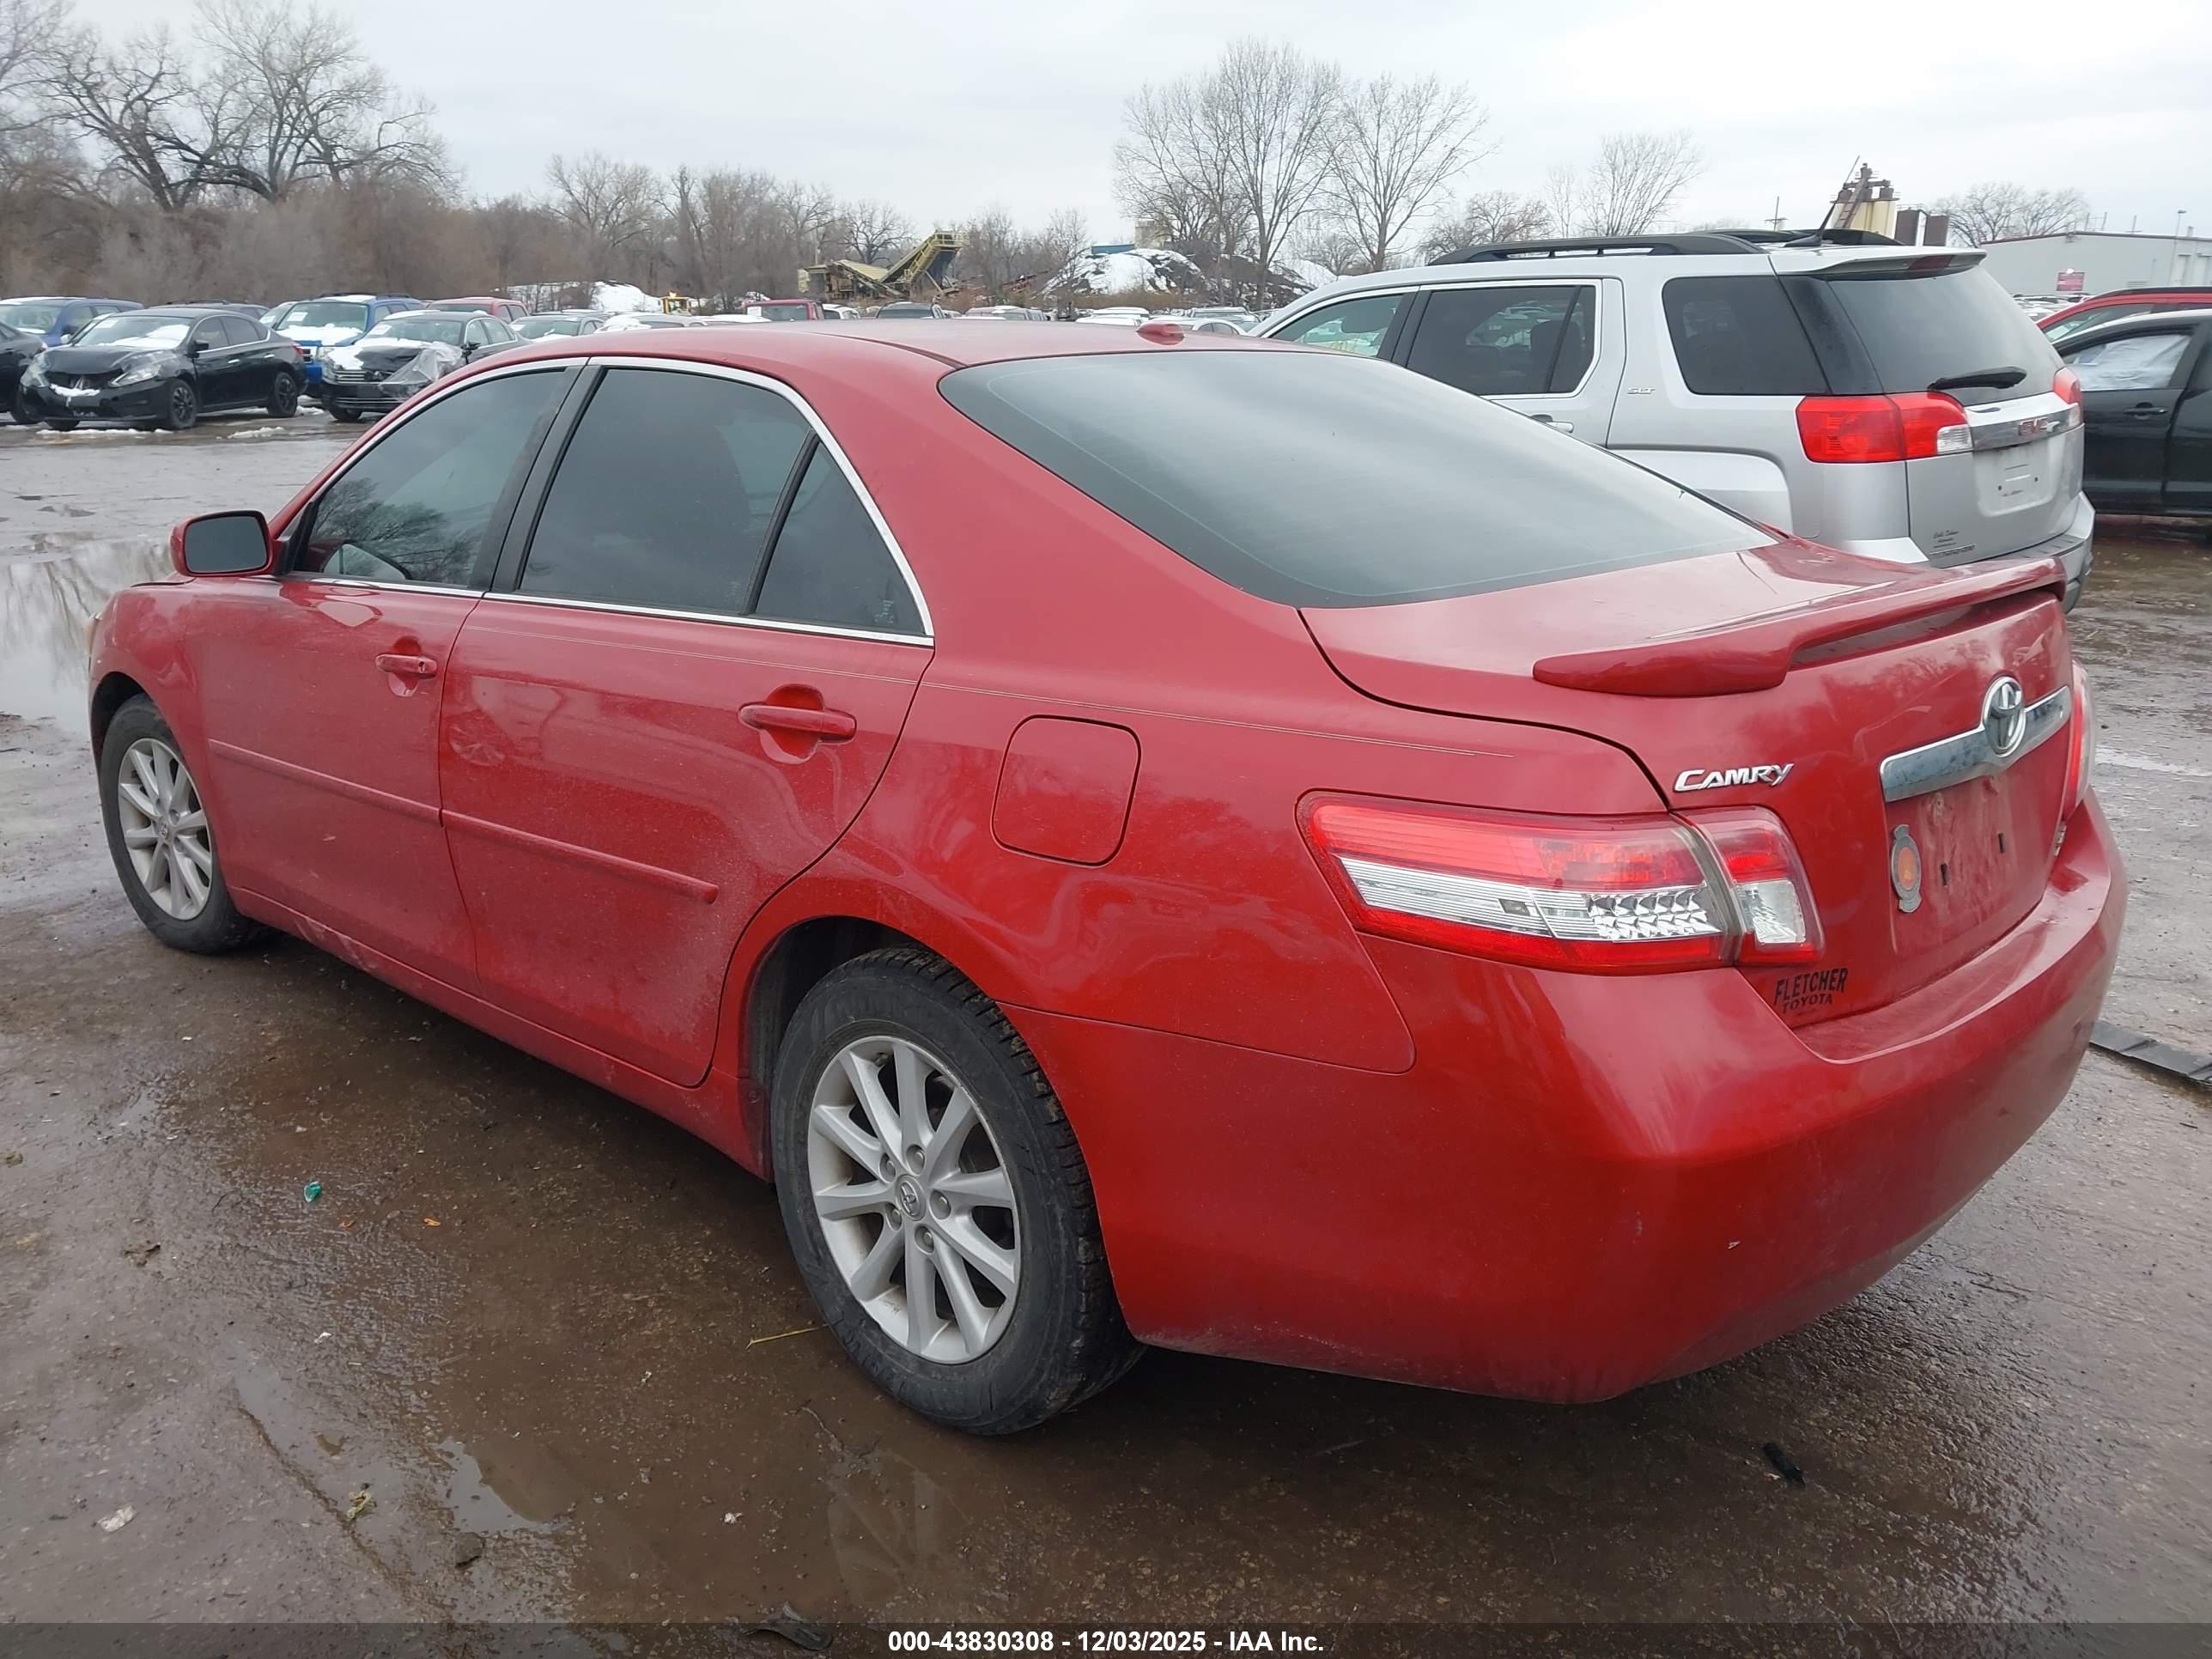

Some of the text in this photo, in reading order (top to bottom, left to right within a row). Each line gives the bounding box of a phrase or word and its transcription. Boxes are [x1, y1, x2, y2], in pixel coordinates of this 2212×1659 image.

[1674, 763, 1795, 793] CAMRY
[1773, 967, 1849, 1006] FLETCHER
[1783, 993, 1832, 1014] TOYOTA
